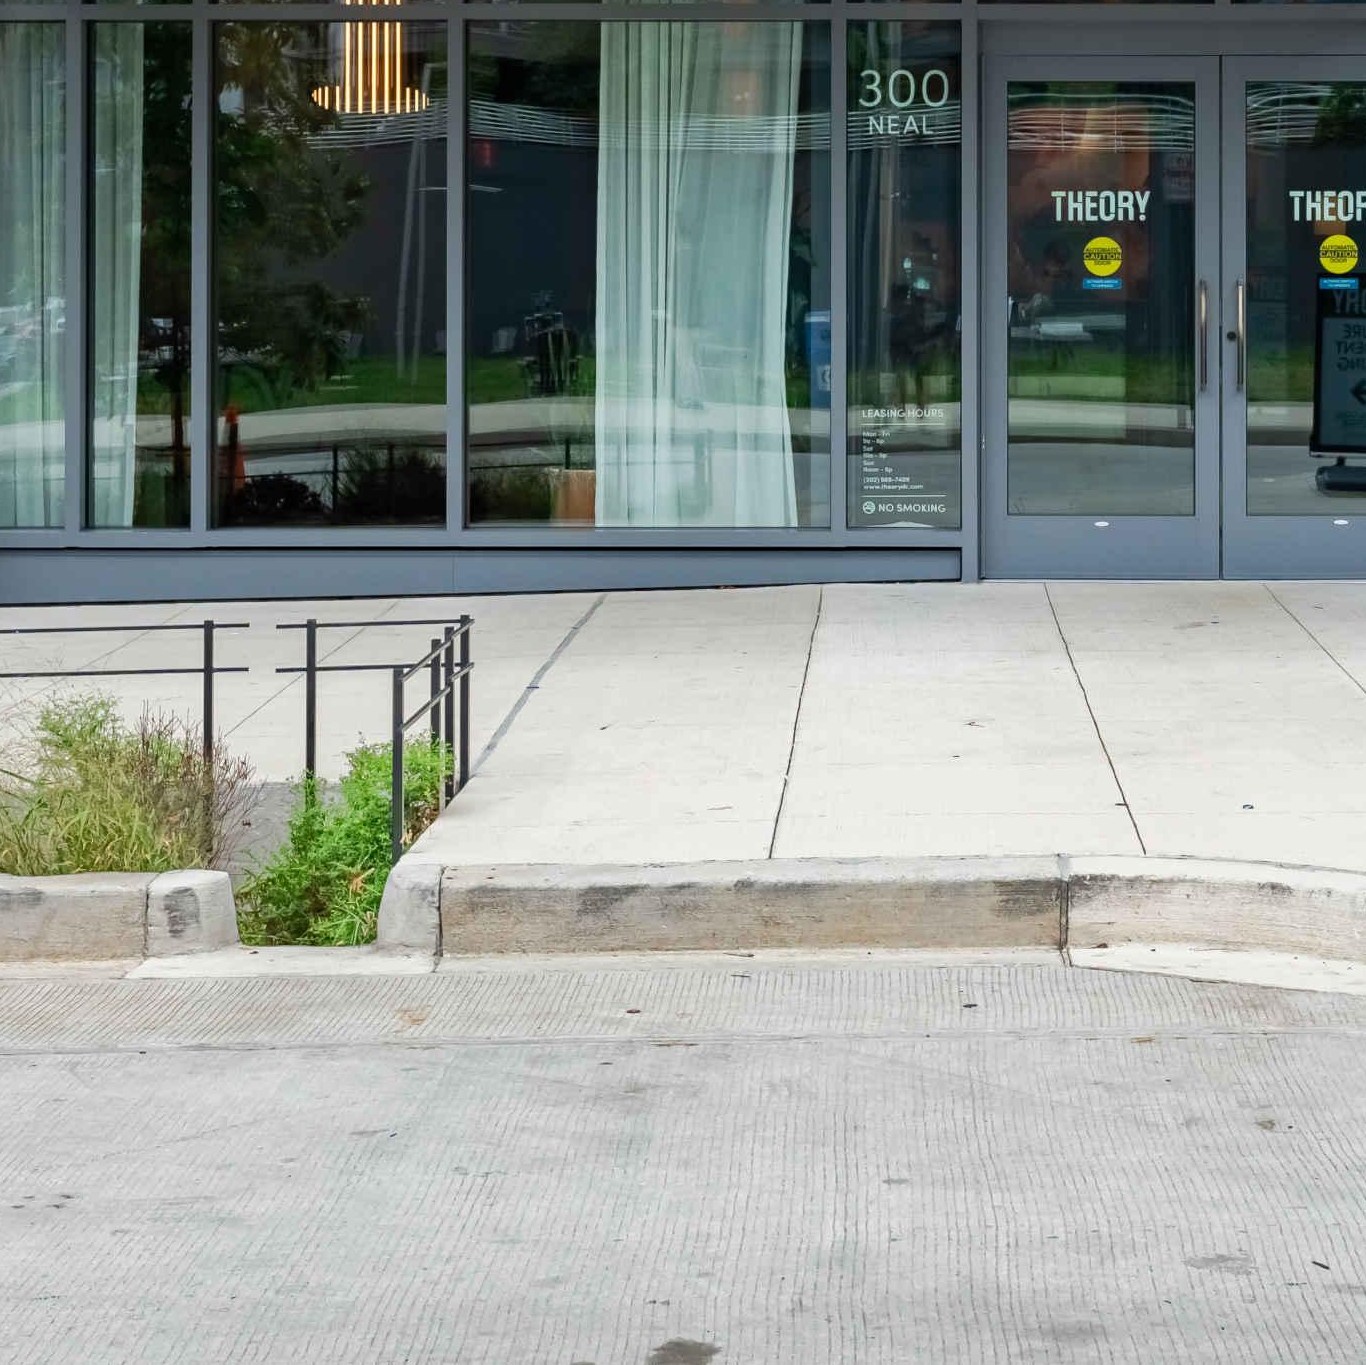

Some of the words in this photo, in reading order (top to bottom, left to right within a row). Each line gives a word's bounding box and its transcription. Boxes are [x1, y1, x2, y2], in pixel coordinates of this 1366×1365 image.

[858, 69, 949, 108] 300
[869, 115, 934, 135] NEAL
[862, 409, 905, 418] LEASING
[908, 408, 944, 417] HOURS
[878, 503, 894, 512] NO
[896, 503, 947, 513] SMOKING
